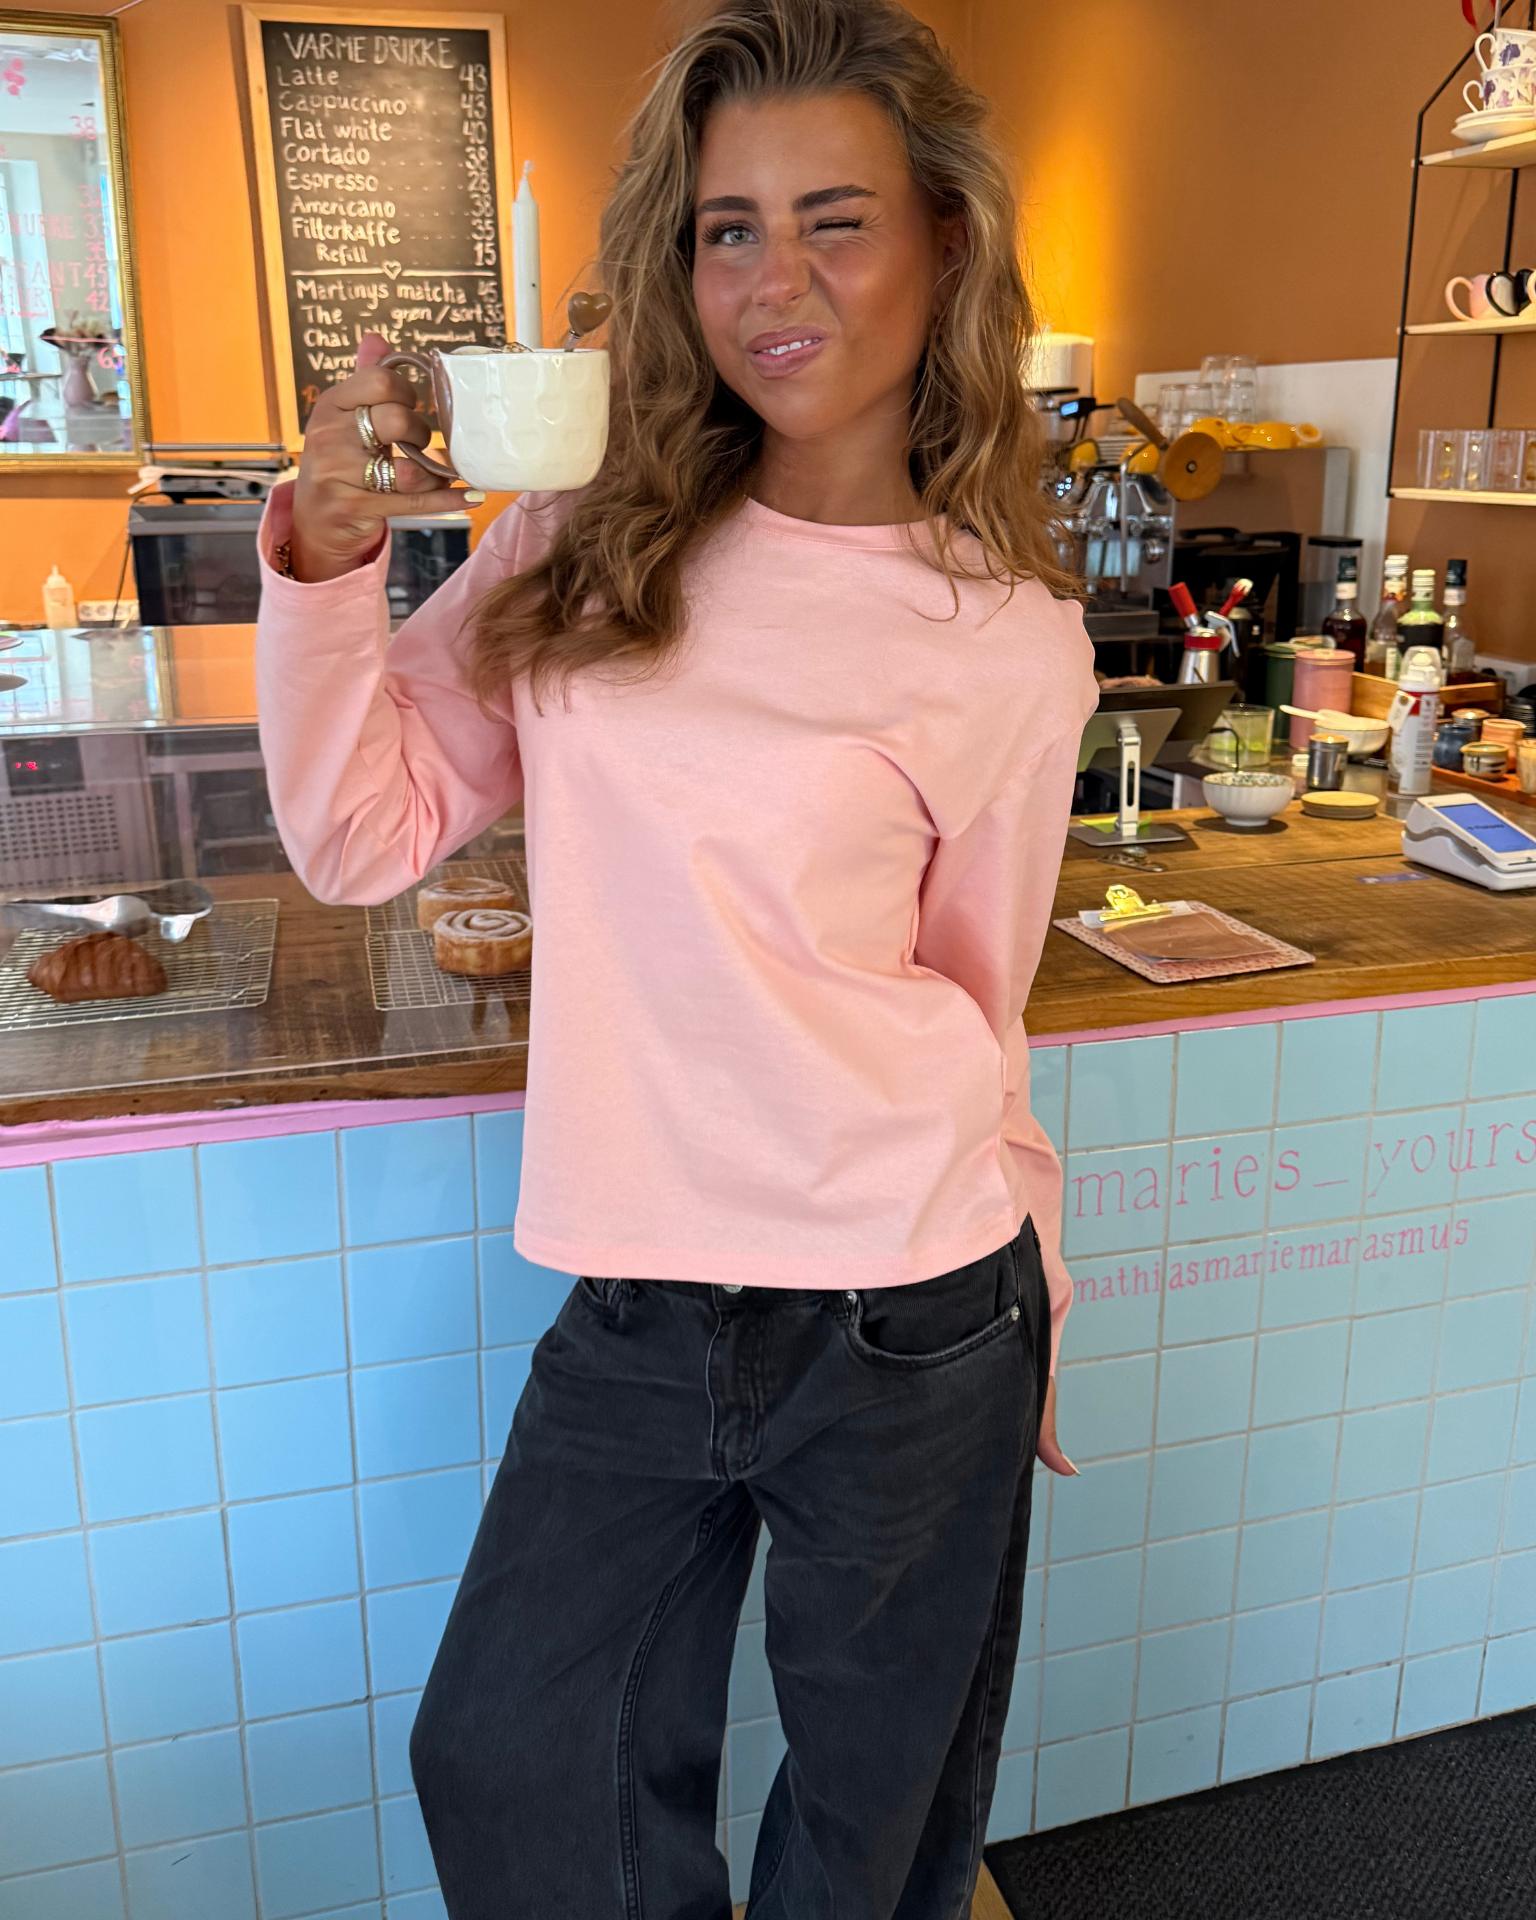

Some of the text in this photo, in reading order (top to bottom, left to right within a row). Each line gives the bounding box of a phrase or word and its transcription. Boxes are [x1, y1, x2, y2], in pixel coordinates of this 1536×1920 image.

[284, 32, 456, 70] VARME DRIKKE
[276, 63, 488, 93] Latte 43
[278, 91, 488, 120] Cappuccino 43
[280, 117, 326, 139] Flat
[333, 117, 393, 142] white
[284, 141, 489, 172] Cortado 38
[286, 167, 379, 193] Espresso
[290, 193, 495, 218] Americano 38
[292, 217, 496, 247] Filterkaffe 35
[315, 242, 497, 267] Refill 15
[397, 280, 467, 304] matcha
[300, 304, 343, 326] The
[303, 326, 351, 347] Chai
